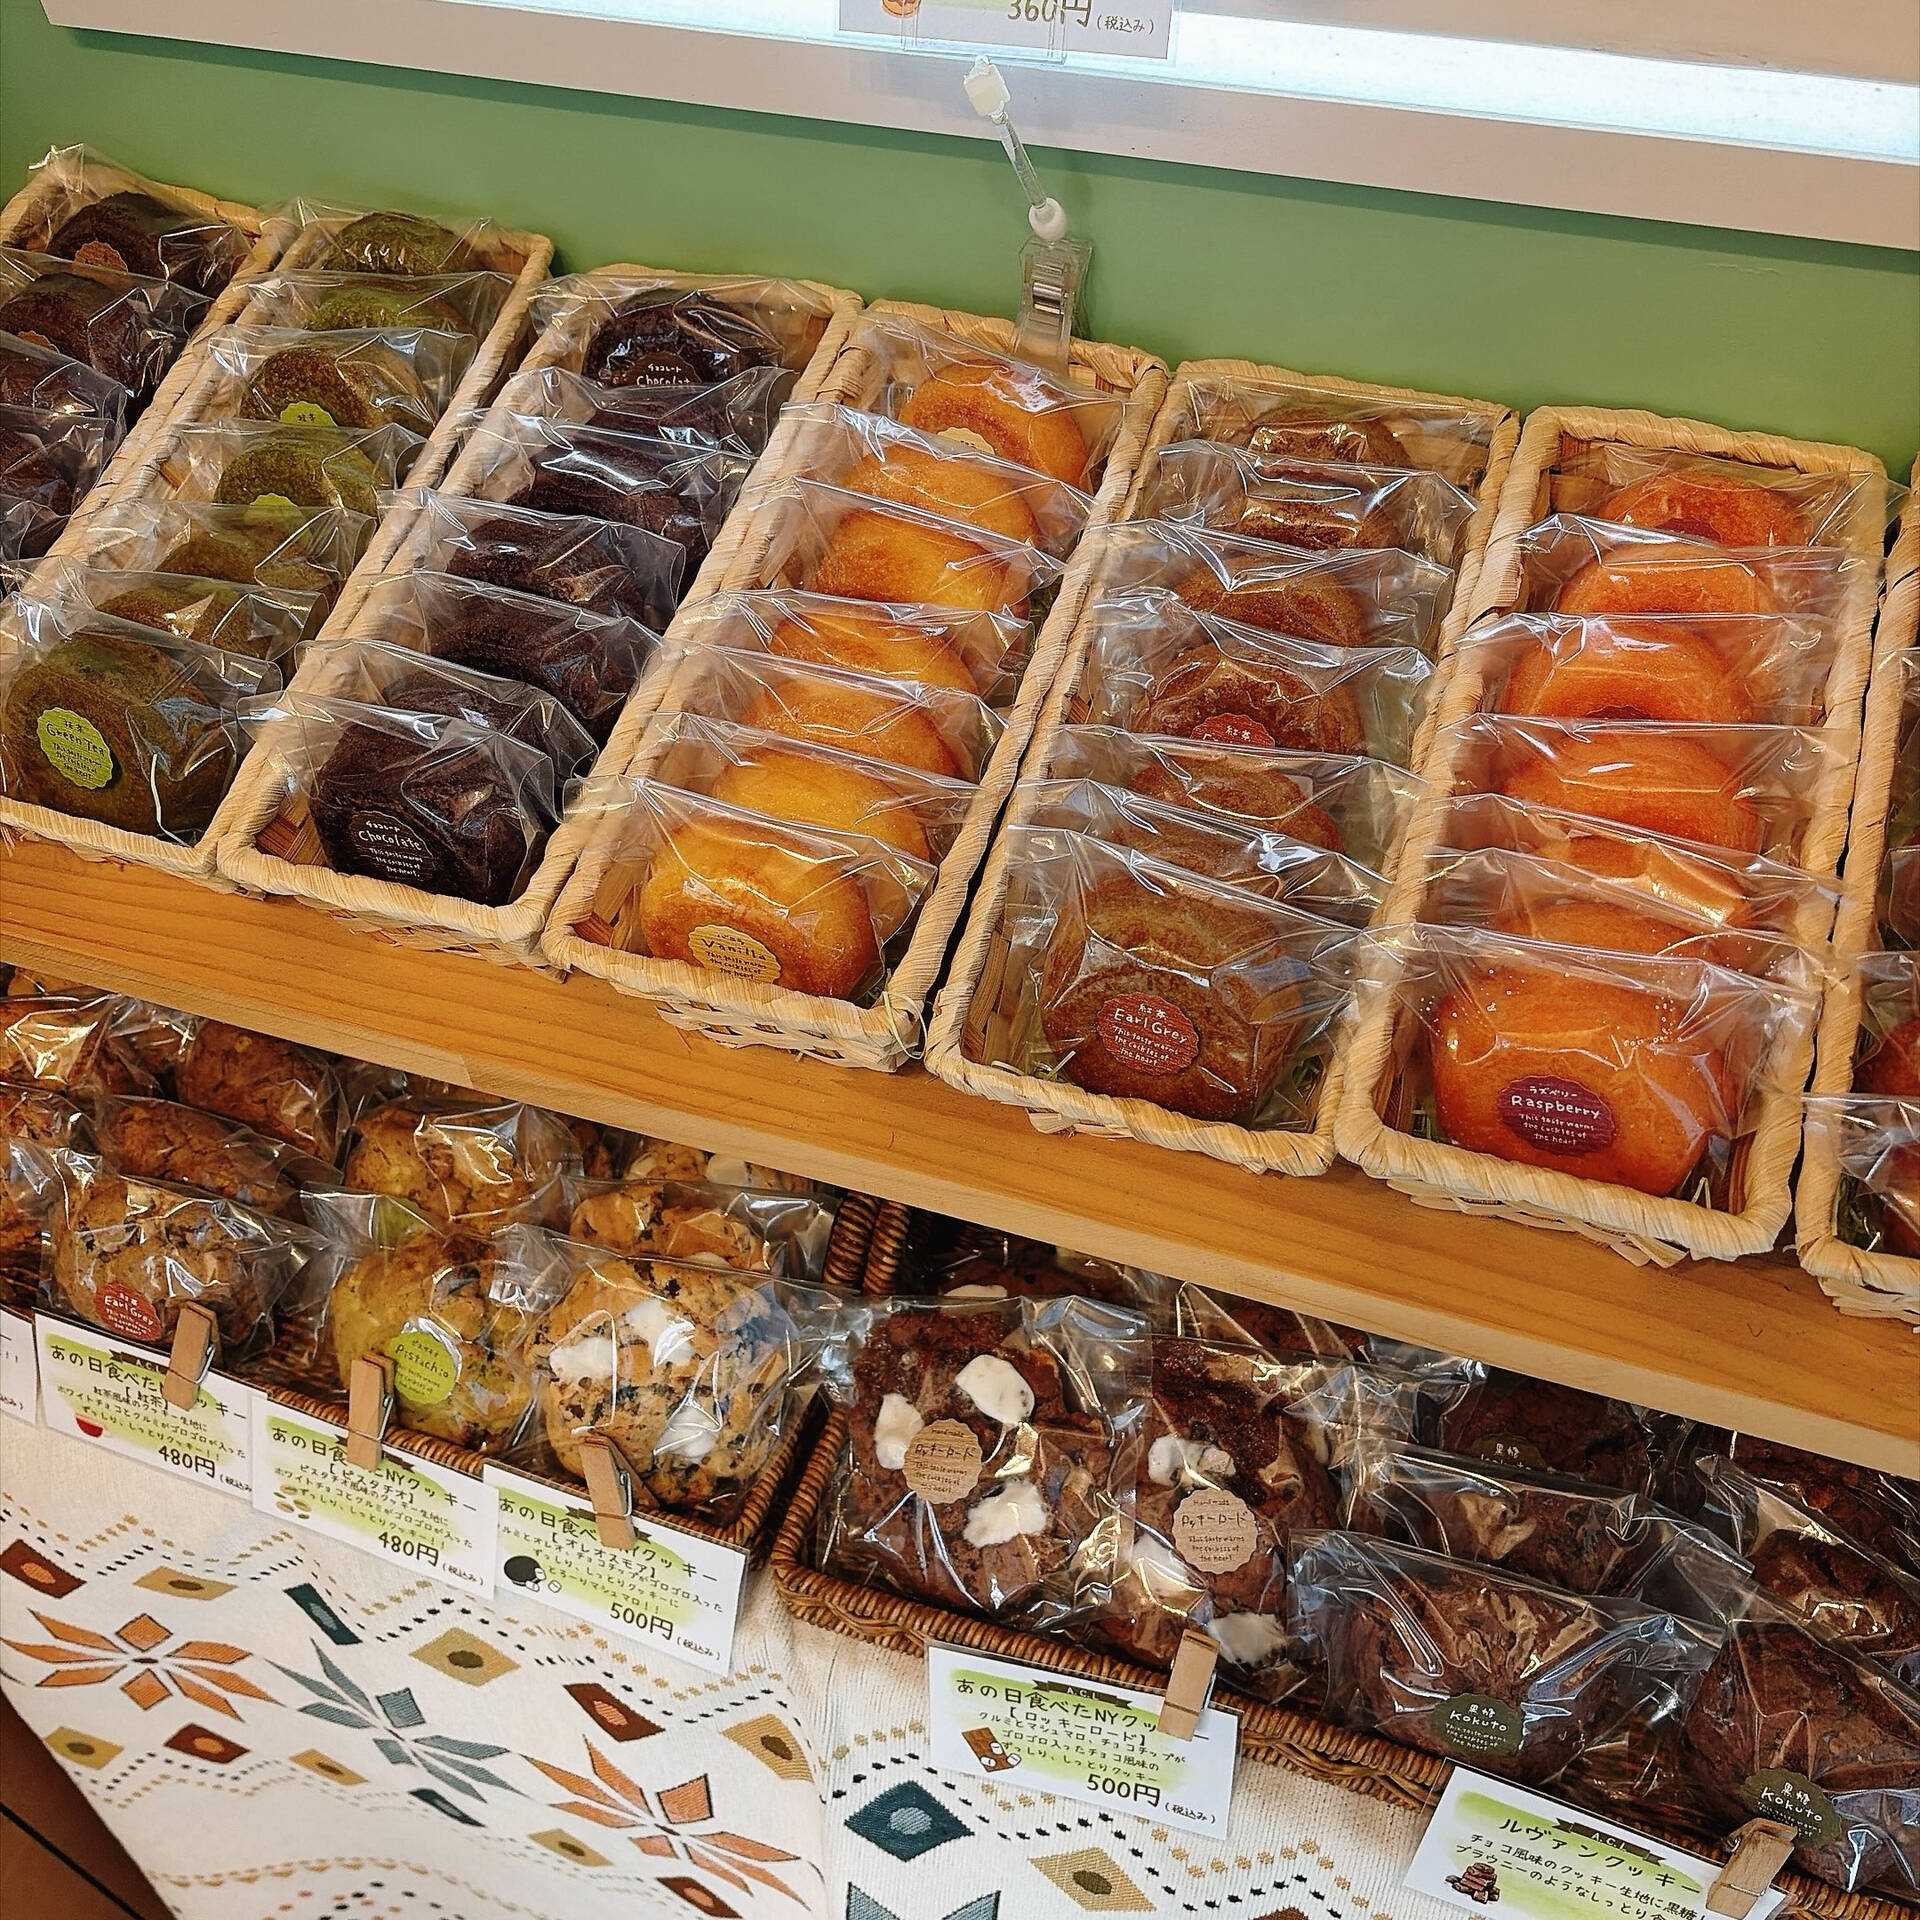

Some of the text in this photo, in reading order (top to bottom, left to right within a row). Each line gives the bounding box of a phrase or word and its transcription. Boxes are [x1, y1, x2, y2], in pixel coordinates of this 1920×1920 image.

[46, 722, 105, 757] Green Tea
[358, 829, 423, 851] Chocolate
[701, 938, 767, 961] Vanilla
[1112, 1026, 1130, 1038] This
[1113, 1008, 1188, 1045] Earl Grey
[1511, 1095, 1600, 1120] Raspberry
[1528, 1085, 1579, 1098] ラズベリー
[1519, 1113, 1539, 1122] This
[104, 1295, 129, 1311] Earl
[130, 1307, 154, 1326] Grey
[158, 1445, 216, 1478] 480円
[329, 1463, 414, 1504] 【ピスタチオ】
[378, 1531, 440, 1568] 480円
[497, 1523, 723, 1613] ルミとオレオ、チョコチップがゴロゴロ入った
[609, 1602, 721, 1661] 500円 (税込み)
[956, 1678, 1209, 1741] あの日食べたNYクッー
[1009, 1706, 1146, 1746] 【ロッキーロード】
[1449, 1709, 1507, 1732] Kokuto
[1002, 1729, 1159, 1772] ゴロゴロ入ったチョコ風味の
[1002, 1741, 1158, 1782] ずっしり、しっとりクッキー
[1087, 1773, 1216, 1825] 500円 (税込み)
[1761, 1786, 1823, 1822] Kokuto
[1499, 1818, 1701, 1894] ルヴァンクッキー
